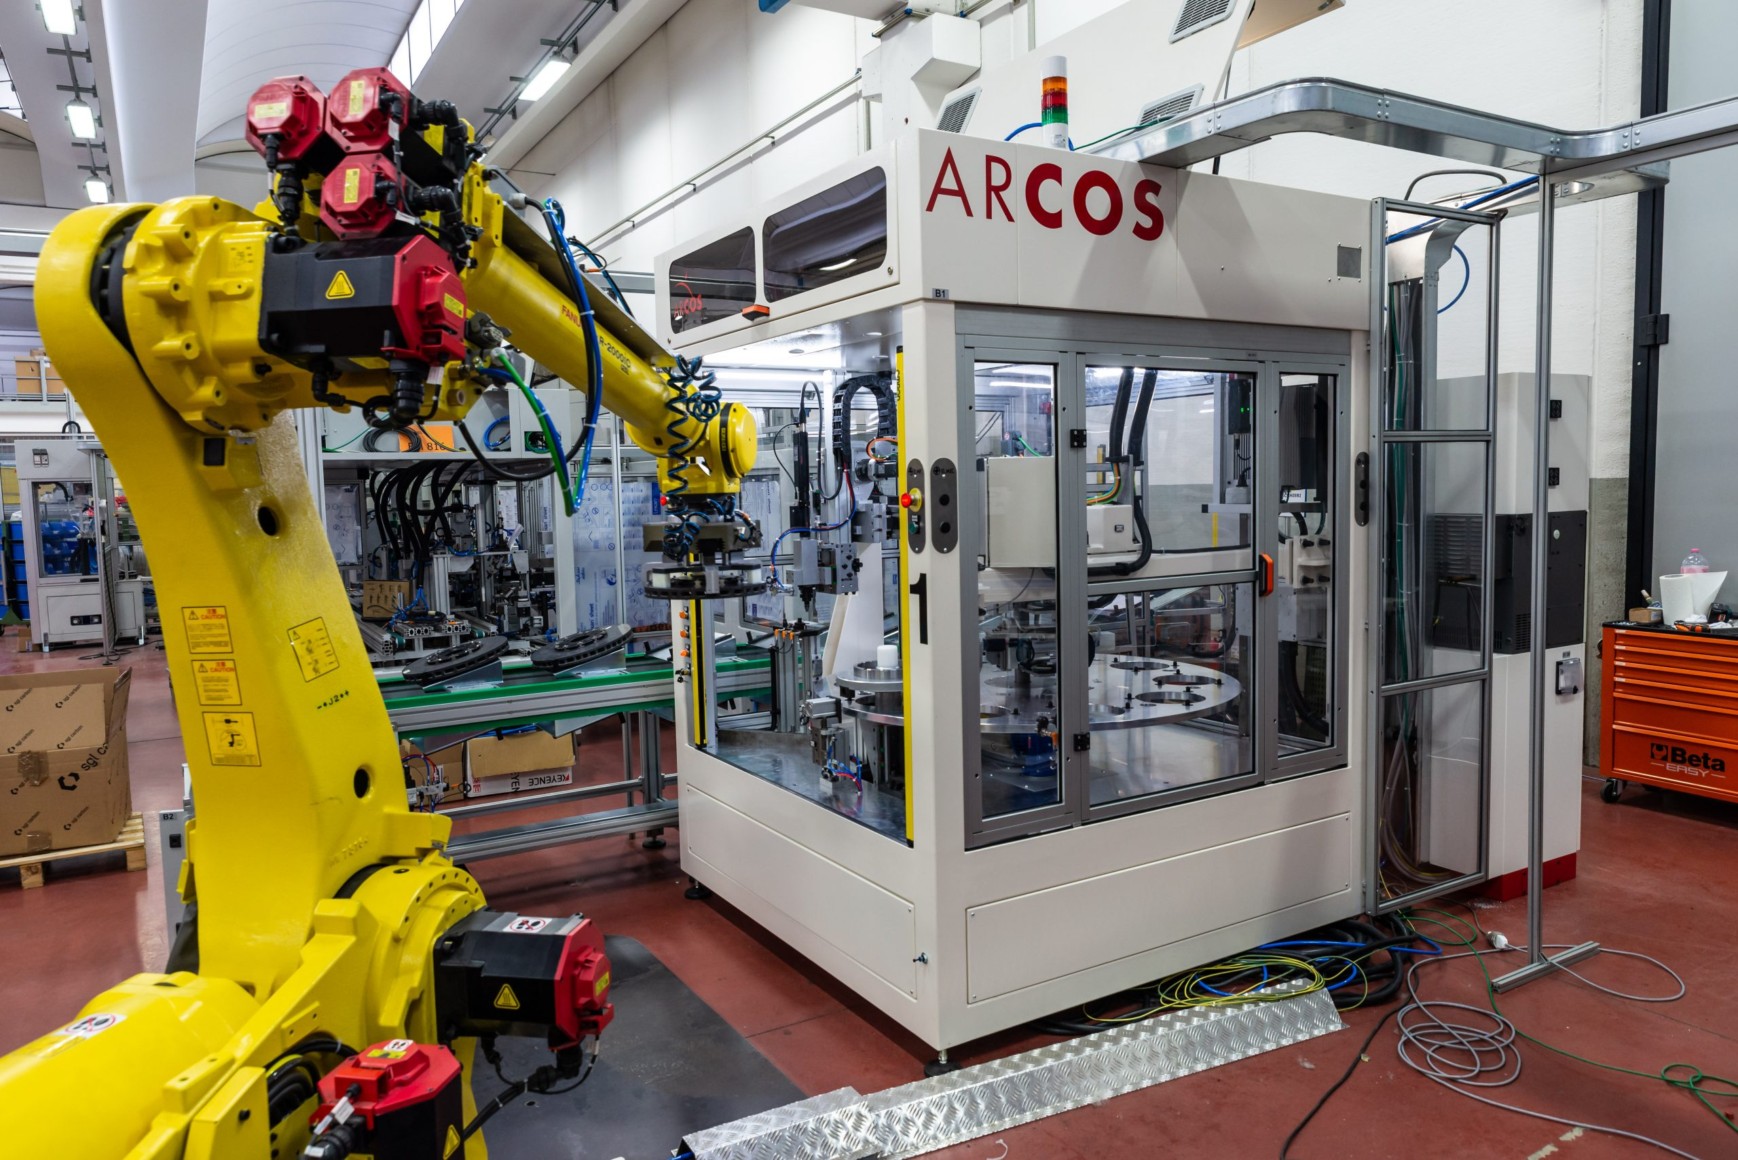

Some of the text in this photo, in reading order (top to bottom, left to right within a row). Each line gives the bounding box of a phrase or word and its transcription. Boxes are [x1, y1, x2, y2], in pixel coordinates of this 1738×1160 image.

[926, 146, 1164, 241] ARCOS
[935, 288, 946, 298] B1
[910, 573, 928, 645] 1
[81, 754, 100, 771] sgl
[1671, 746, 1726, 772] Beta
[1666, 762, 1710, 778] EASY
[528, 773, 570, 786] KEYENCE
